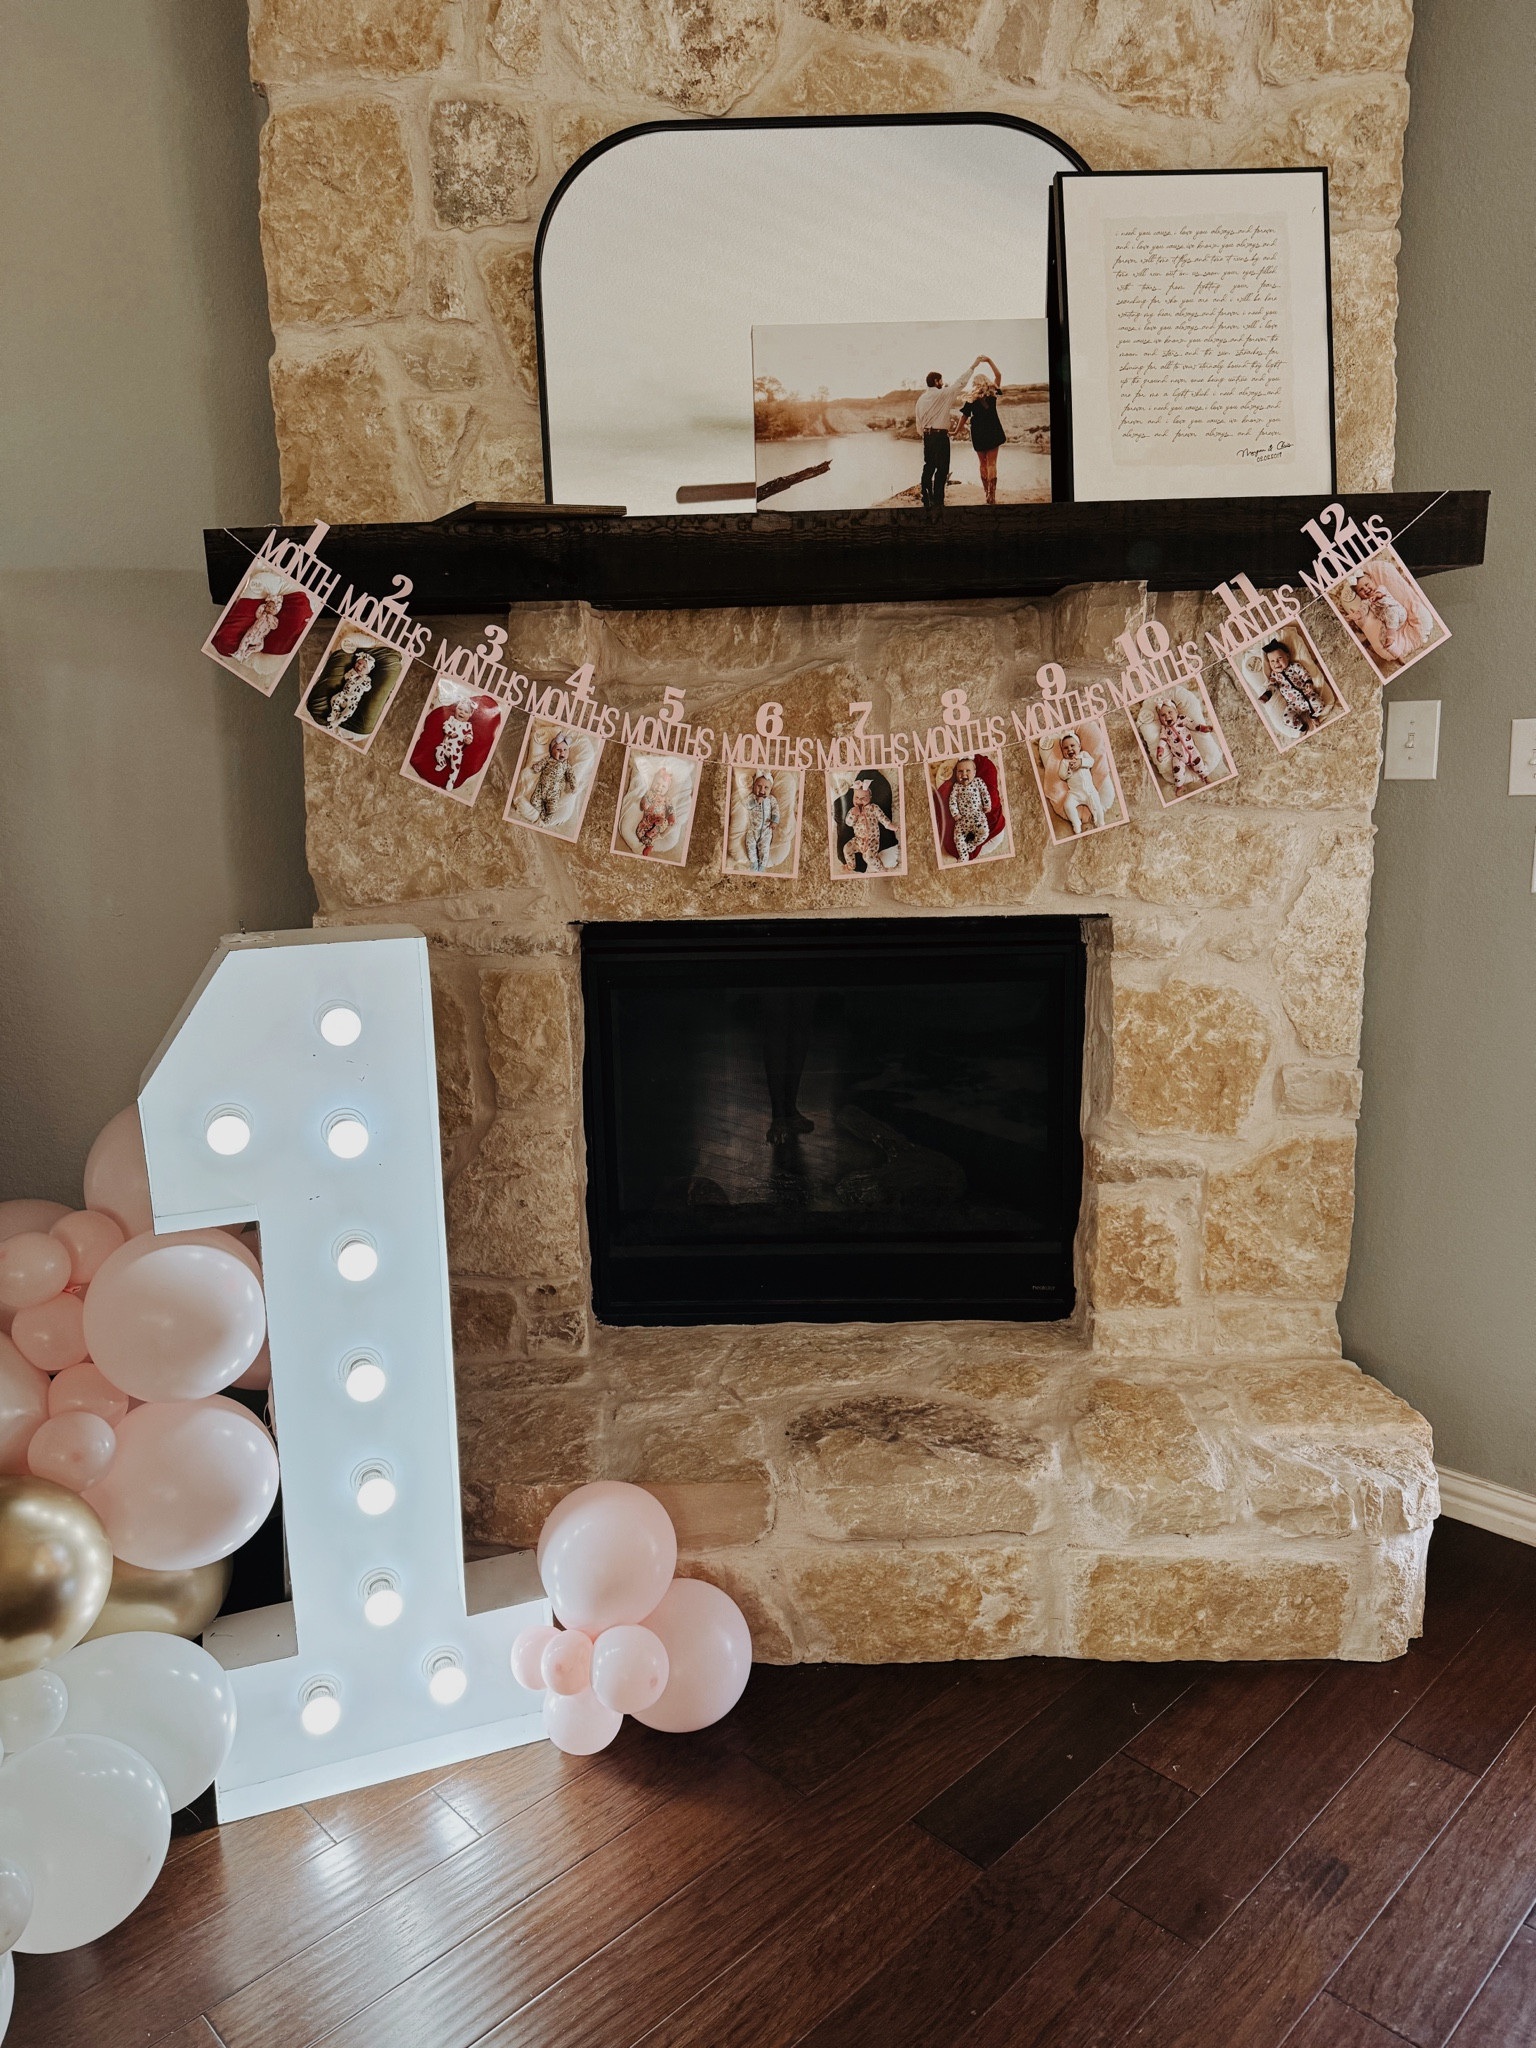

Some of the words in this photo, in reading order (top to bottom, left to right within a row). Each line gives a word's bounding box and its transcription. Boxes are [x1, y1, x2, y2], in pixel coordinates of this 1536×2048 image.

[1116, 241, 1130, 250] and
[1137, 241, 1150, 250] love
[1149, 245, 1164, 254] you
[1219, 244, 1234, 253] you
[1236, 238, 1260, 252] always
[1263, 238, 1278, 247] and
[1135, 230, 1151, 241] you
[1180, 225, 1192, 235] love
[1193, 230, 1208, 240] you
[1211, 225, 1235, 239] always
[1238, 225, 1253, 233] and
[1251, 225, 1276, 239] forever
[1112, 255, 1138, 269] forever
[1195, 254, 1211, 262] and
[1263, 252, 1278, 260] and
[1175, 307, 1199, 321] always
[1202, 308, 1217, 316] and
[1214, 308, 1240, 321] forever
[1262, 311, 1277, 320] you
[1179, 299, 1194, 308] you
[1213, 294, 1227, 302] and
[1116, 340, 1130, 348] you
[1186, 338, 1201, 348] you
[1204, 333, 1227, 347] always
[1230, 333, 1245, 342] and
[1243, 334, 1266, 347] forever
[1144, 321, 1157, 331] love
[1157, 326, 1172, 335] you
[1175, 321, 1199, 335] always
[1202, 320, 1217, 329] and
[1214, 322, 1240, 334] forever
[1265, 319, 1278, 329] love
[1143, 348, 1158, 356] and
[1184, 347, 1199, 356] and
[1239, 386, 1266, 401] always
[1266, 386, 1281, 395] and
[1251, 373, 1266, 382] and
[1265, 377, 1280, 387] you
[1118, 416, 1143, 430] forever
[1147, 415, 1162, 424] and
[1173, 414, 1186, 424] love
[1188, 419, 1203, 429] you
[1265, 418, 1281, 427] you
[1120, 403, 1146, 416] forever
[1167, 406, 1183, 416] you
[1210, 401, 1223, 410] love
[1223, 405, 1238, 415] you
[1240, 400, 1264, 415] always
[1266, 400, 1282, 410] and
[1122, 428, 1151, 443] always
[1154, 428, 1169, 437] and
[1172, 429, 1197, 443] forever
[1205, 427, 1234, 442] always
[1237, 427, 1252, 436] and
[1255, 428, 1281, 442] forever
[299, 518, 331, 557] 1
[1300, 502, 1358, 556] 12
[257, 528, 342, 603] MONTH
[1298, 514, 1393, 598] MONTHS
[381, 574, 414, 611] 2
[1211, 571, 1265, 618] 11
[338, 584, 433, 658] MONTHS
[1204, 583, 1301, 659] MONTHS
[476, 624, 509, 663] 3
[1114, 620, 1170, 668] 10
[433, 638, 529, 707] MONTHS
[565, 662, 597, 700] 4
[1035, 662, 1067, 700] 9
[1105, 640, 1204, 708] MONTHS
[524, 681, 621, 739] MONTHS
[659, 685, 687, 723] 5
[755, 701, 784, 738] 6
[849, 701, 873, 738] 7
[940, 688, 972, 726] 8
[1011, 683, 1108, 741] MONTHS
[622, 711, 715, 760] MONTHS
[722, 731, 814, 770] MONTHS
[817, 732, 910, 770] MONTHS
[912, 715, 1007, 762] MONTHS
[138, 926, 556, 1824] 1
